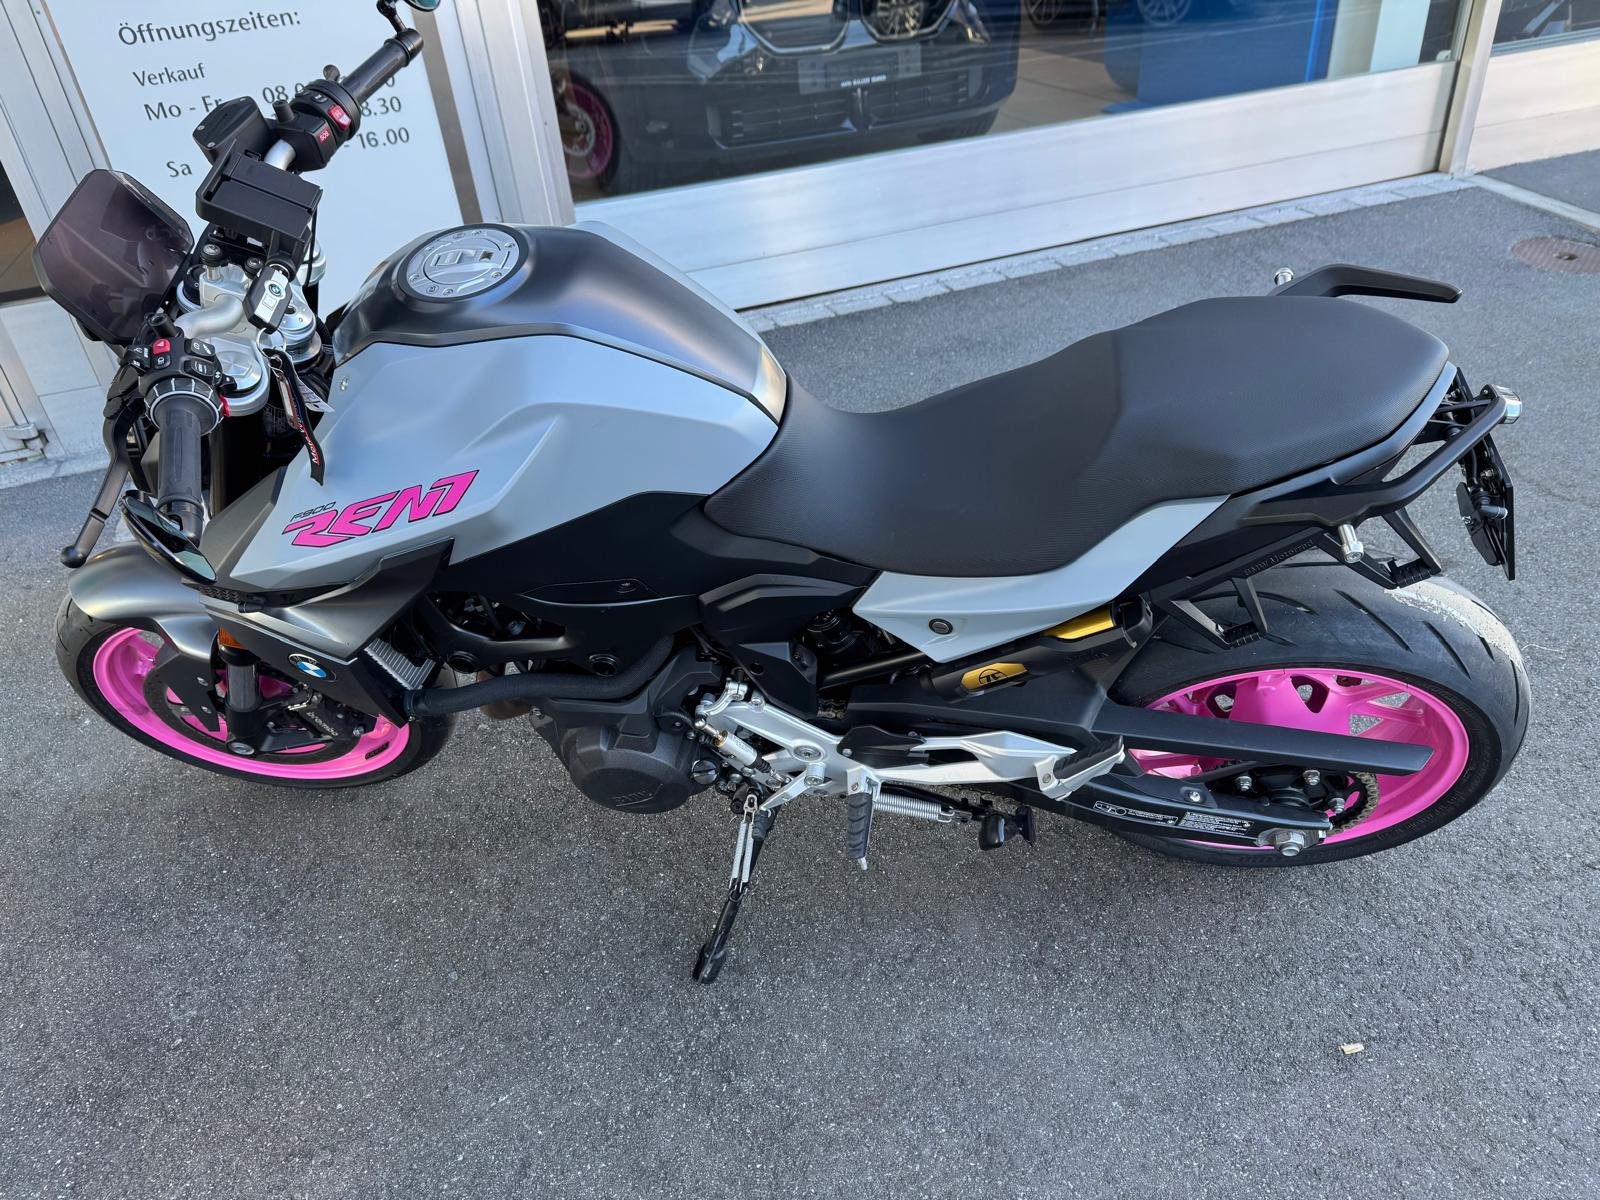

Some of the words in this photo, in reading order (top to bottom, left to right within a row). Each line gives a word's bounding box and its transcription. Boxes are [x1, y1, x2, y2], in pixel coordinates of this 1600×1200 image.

[118, 11, 301, 45] Öffnungszeiten:
[132, 63, 206, 87] Verkauf
[144, 102, 182, 121] Mo
[360, 96, 401, 117] 8.30
[356, 126, 410, 149] 16.00
[166, 160, 193, 178] Sa
[289, 501, 337, 523] F900
